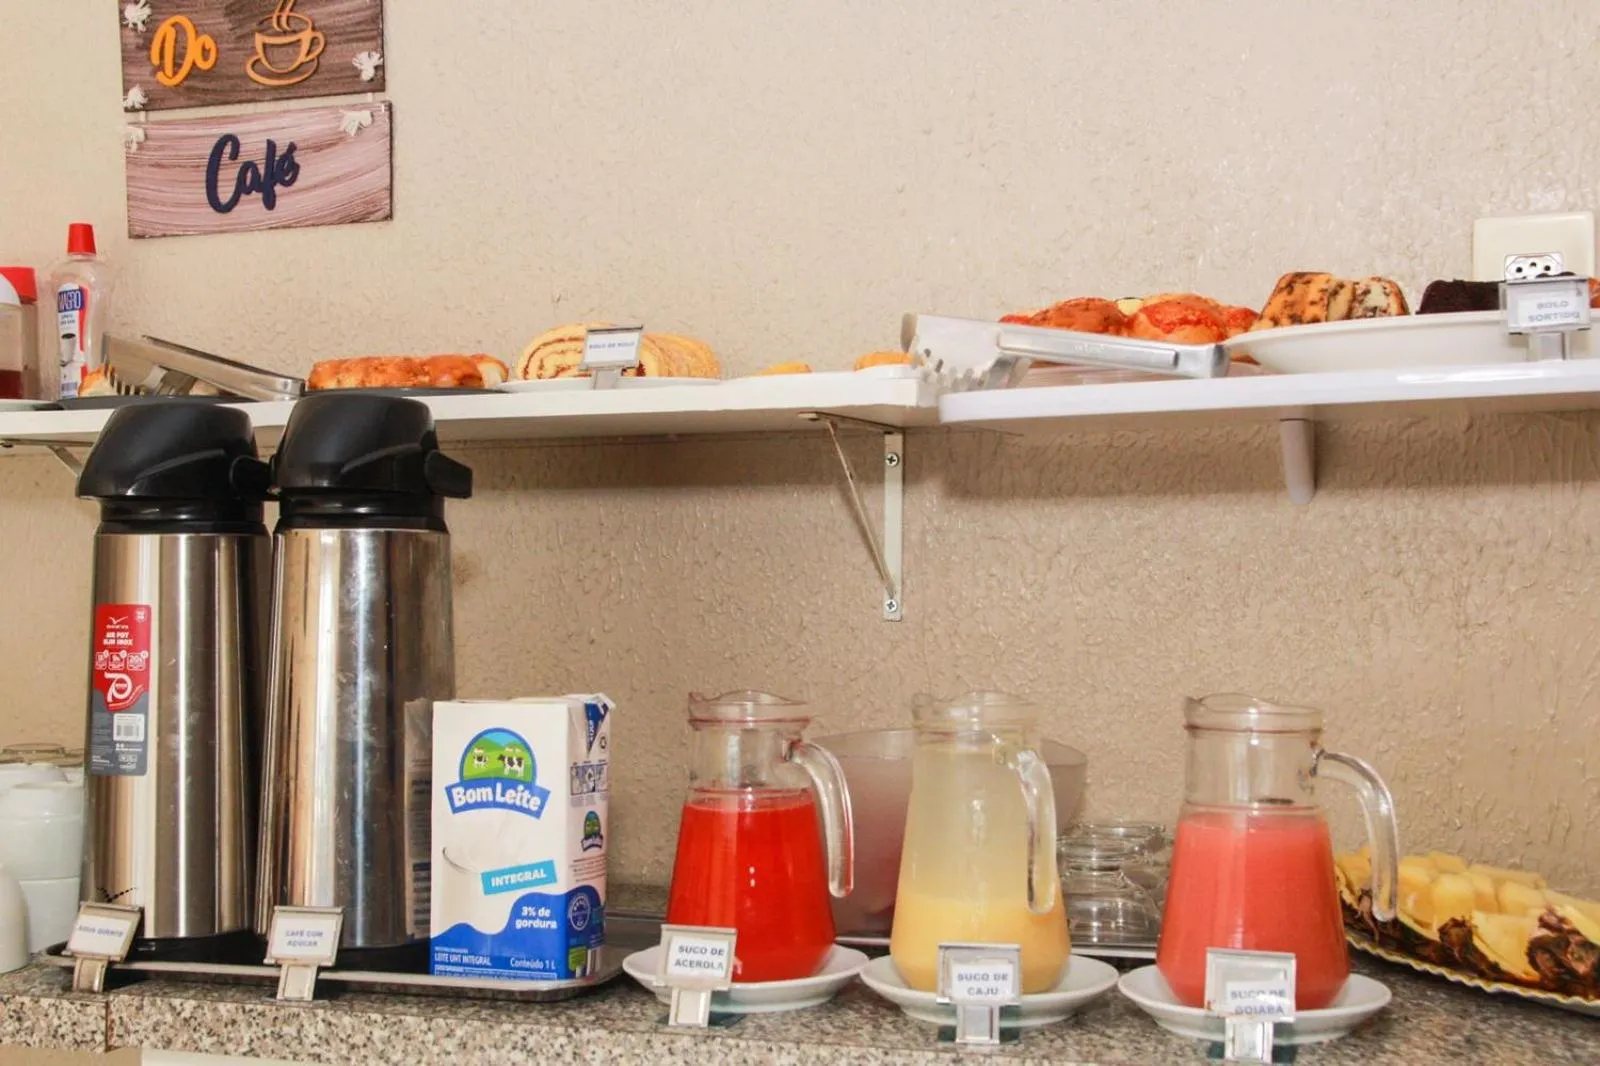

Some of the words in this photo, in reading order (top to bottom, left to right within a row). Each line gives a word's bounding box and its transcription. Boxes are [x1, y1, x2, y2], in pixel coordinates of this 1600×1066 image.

[151, 15, 217, 87] Do
[205, 133, 300, 214] Café
[451, 785, 494, 808] Bom
[495, 782, 542, 811] Leite
[491, 867, 547, 887] INTEGRAL
[521, 906, 536, 917] 3%
[538, 906, 551, 917] de
[515, 918, 558, 930] gordura
[678, 945, 708, 955] SUCO
[710, 947, 725, 957] DE
[434, 952, 449, 962] LEITE
[462, 954, 492, 966] INTEGRAL
[510, 957, 544, 969] Conteúdo
[674, 958, 725, 972] ACEROLA
[957, 972, 990, 982] SUCO
[993, 972, 1009, 982] DE
[966, 987, 999, 997] CAJU
